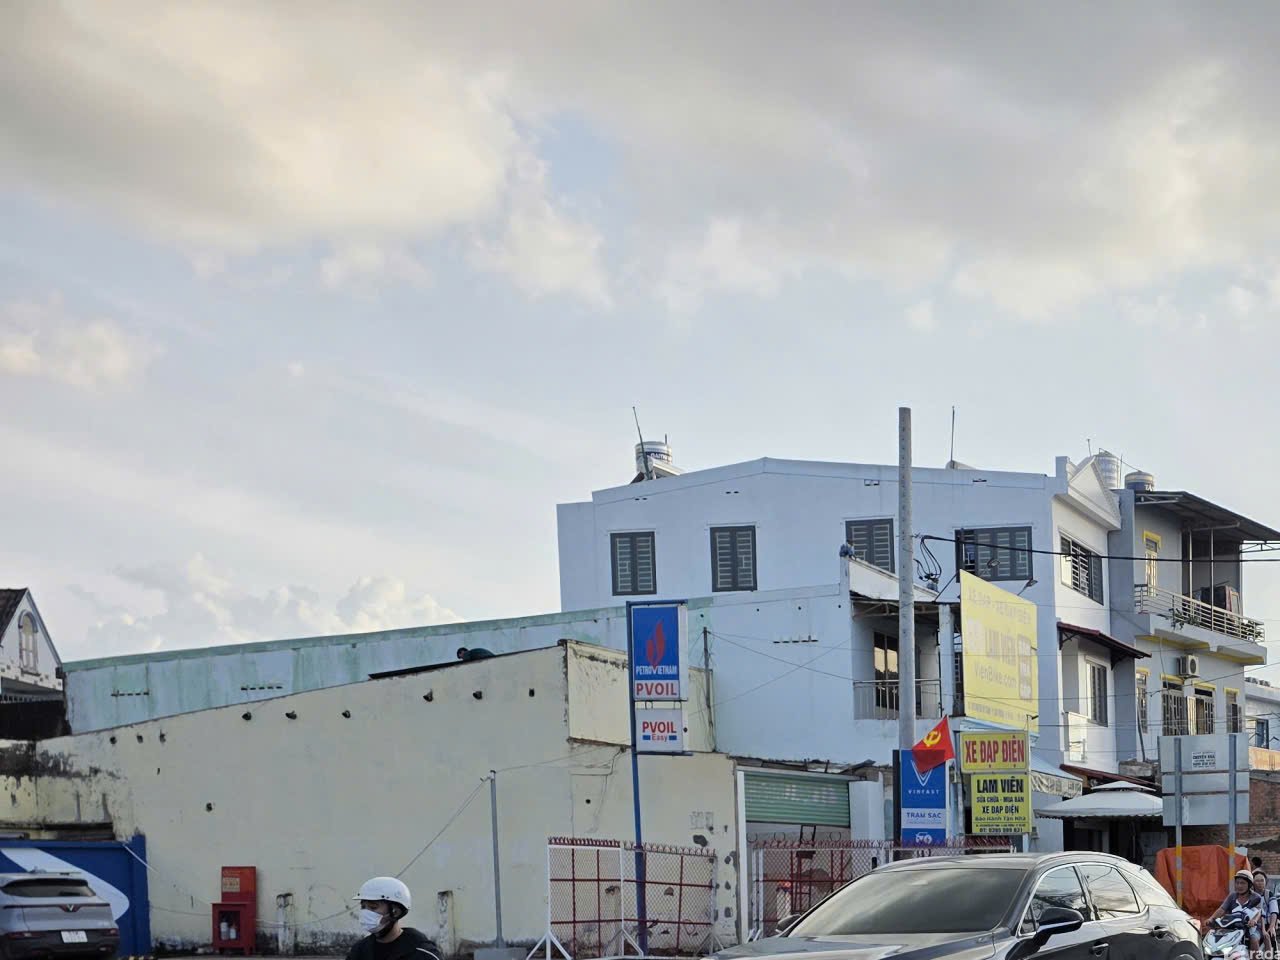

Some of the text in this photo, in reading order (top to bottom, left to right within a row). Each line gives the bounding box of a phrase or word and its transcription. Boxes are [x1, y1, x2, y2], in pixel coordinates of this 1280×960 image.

[636, 665, 678, 675] PETROVIETNAM
[636, 682, 677, 695] PVOIL
[642, 721, 677, 733] PVOIL
[652, 734, 668, 742] Easy
[965, 735, 1025, 768] XE ĐẠP ĐIỆN
[977, 776, 1024, 793] LAM VIÊN
[906, 812, 942, 820] TRẠM SẠC
